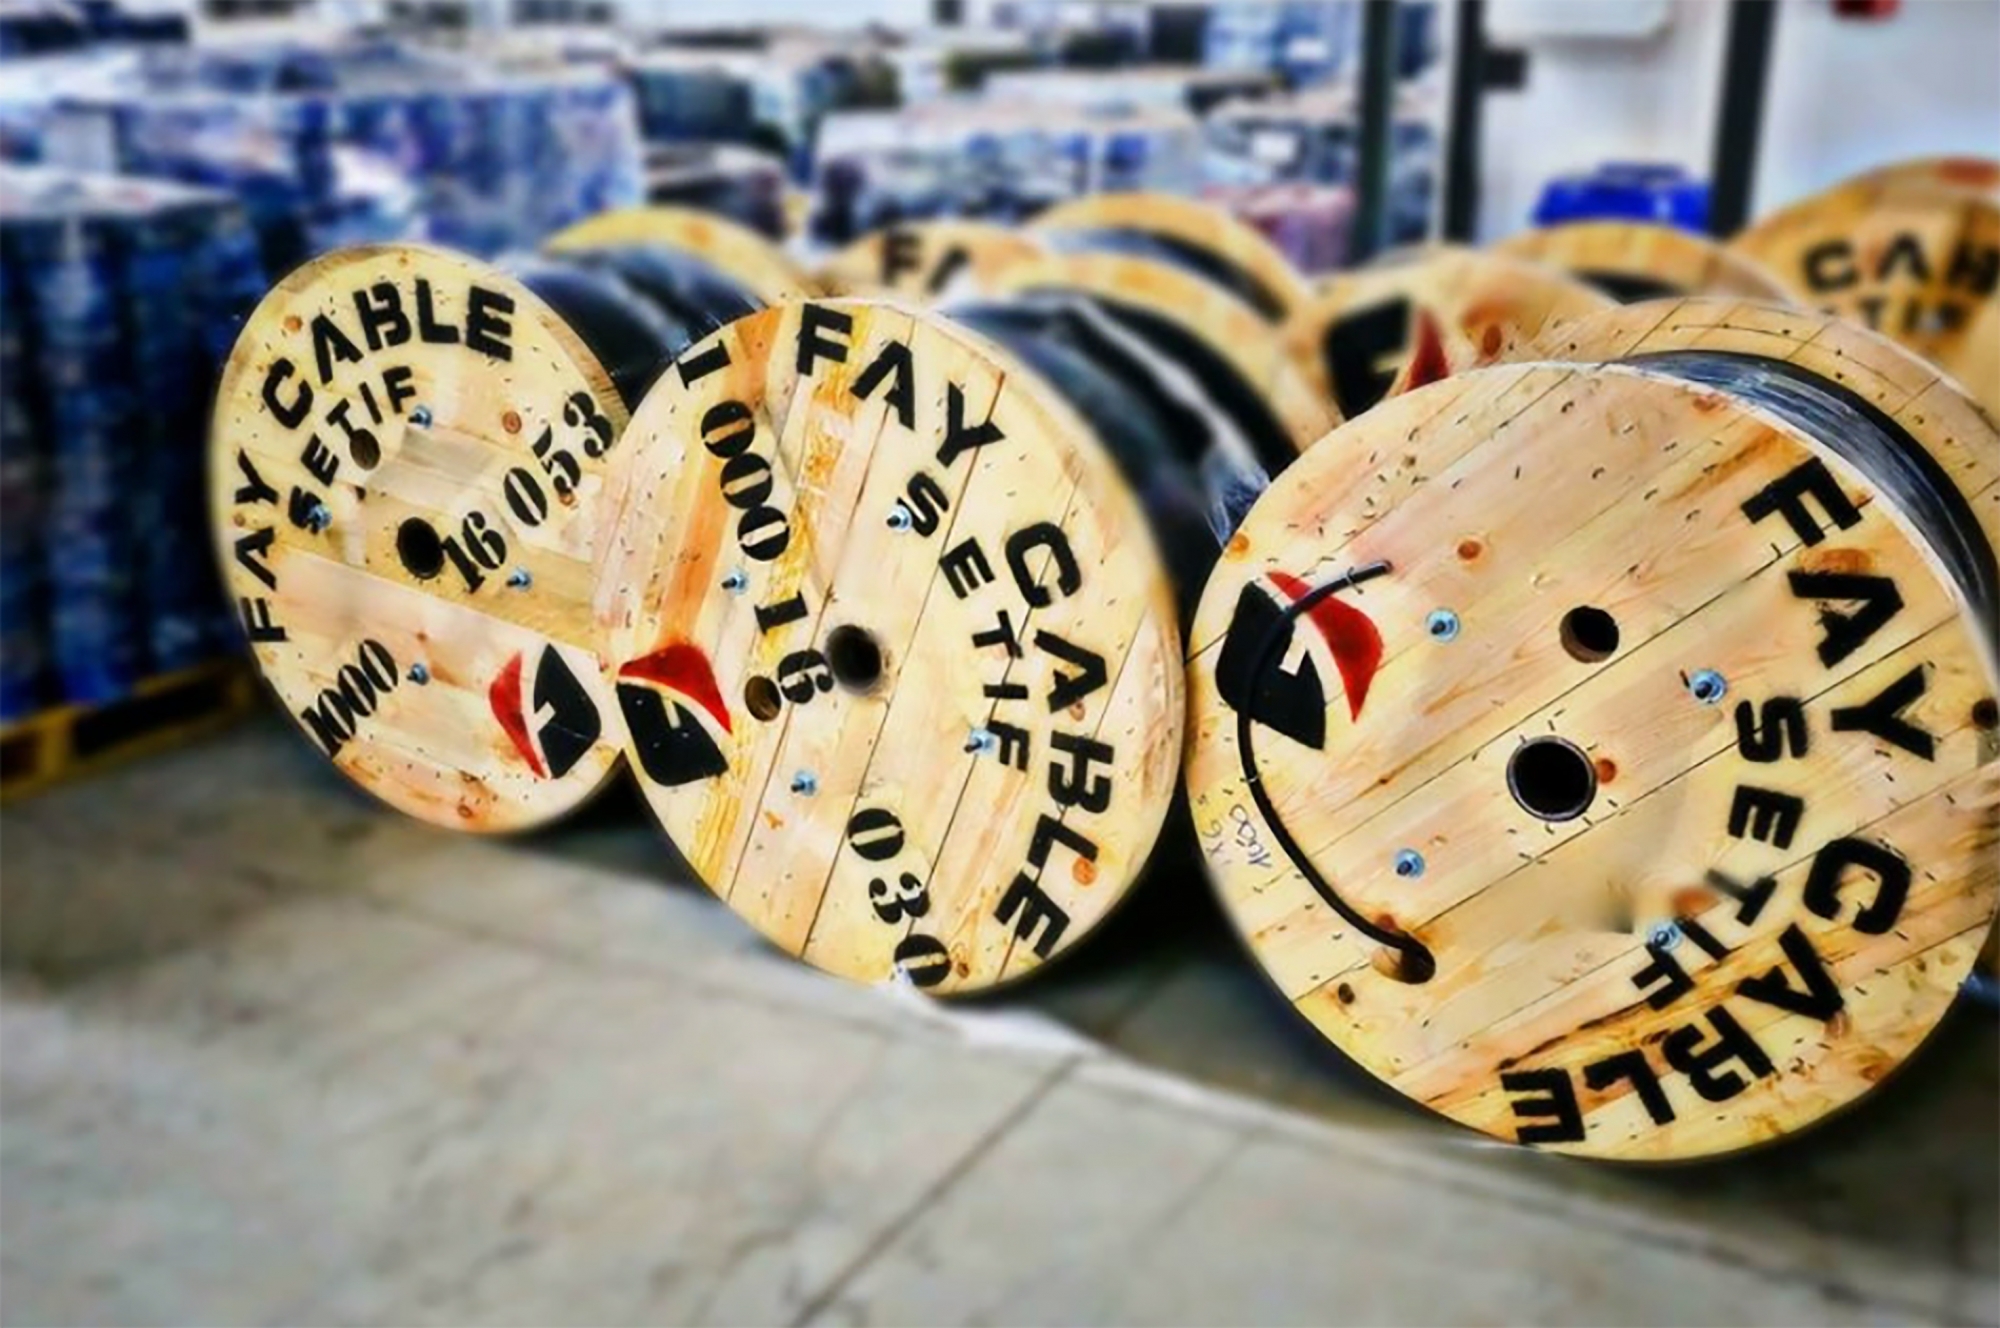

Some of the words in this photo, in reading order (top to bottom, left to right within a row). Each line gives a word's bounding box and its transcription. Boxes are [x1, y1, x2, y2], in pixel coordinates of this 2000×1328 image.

[234, 448, 290, 644] FAY
[262, 277, 516, 429] CABLE
[288, 365, 417, 535] SETIF
[444, 510, 508, 595] 16
[503, 391, 613, 527] 053
[303, 638, 399, 758] 1000
[796, 303, 1007, 468] FAY
[994, 521, 1115, 959] CABLE
[892, 470, 1032, 773] SETIF
[1741, 457, 1938, 762] FAY
[753, 590, 834, 705] 16
[848, 807, 954, 988] 030
[1630, 696, 1810, 1012] SETIF
[1500, 837, 1913, 1146] CABLE
